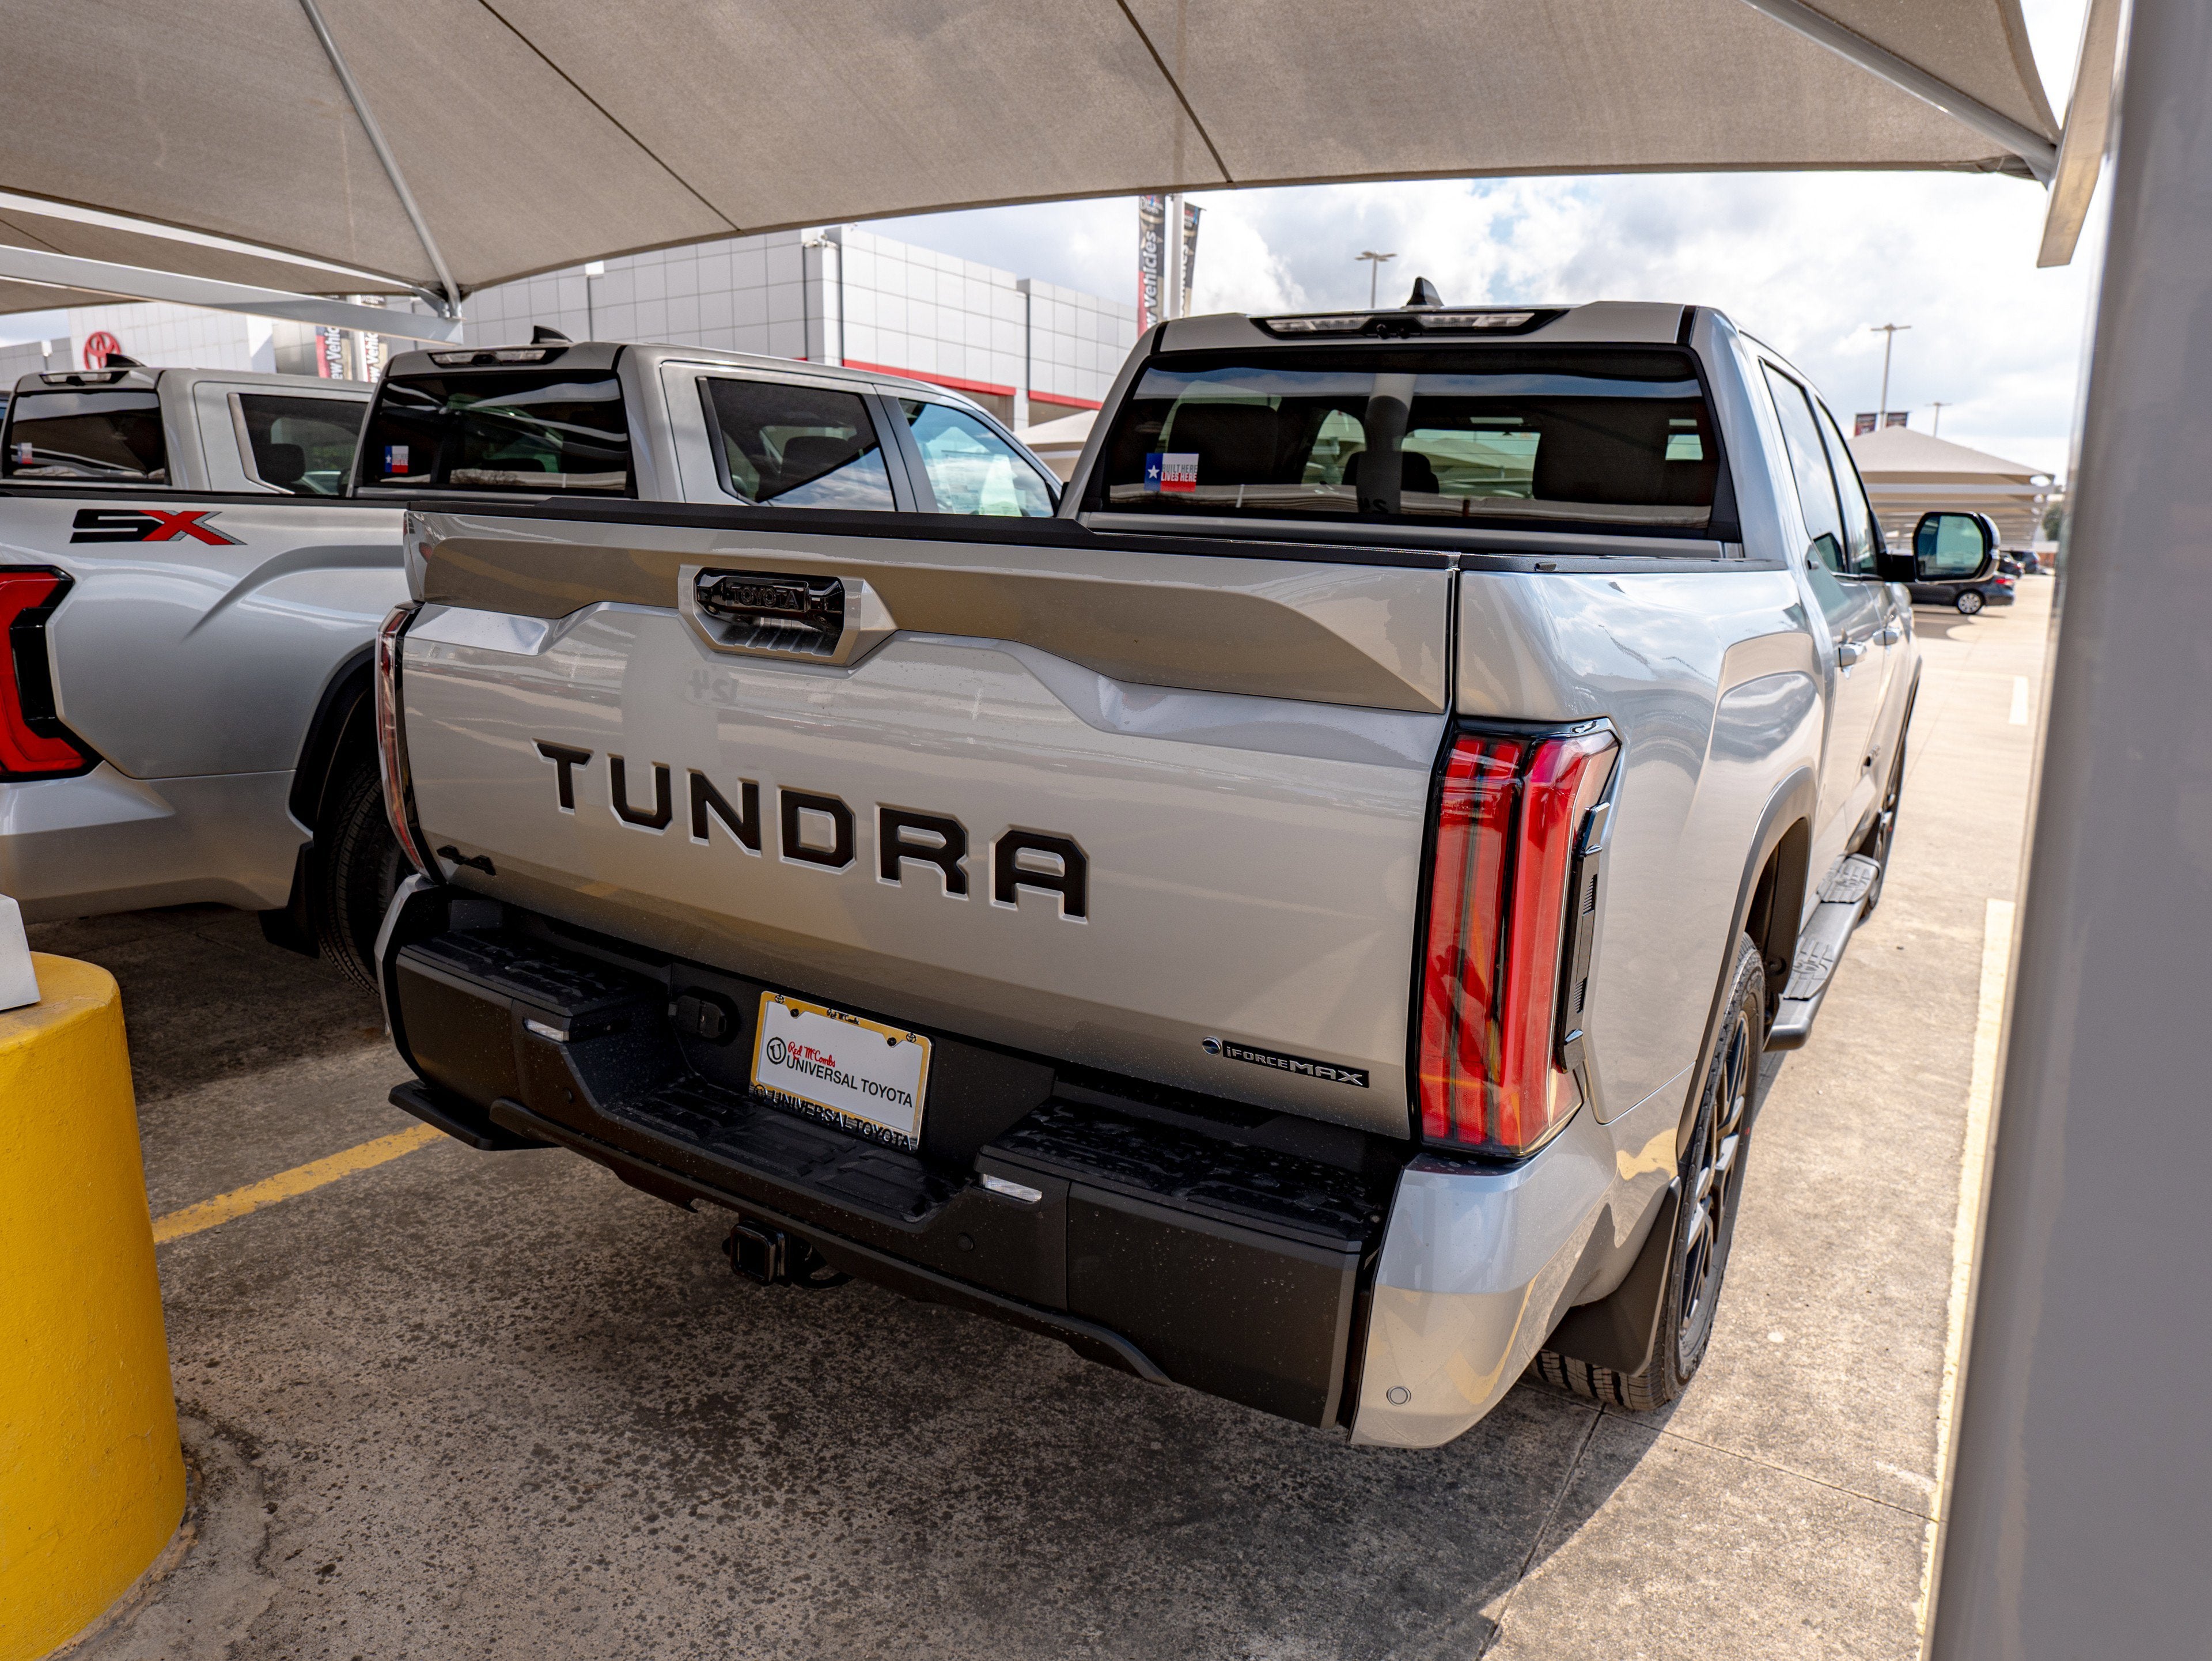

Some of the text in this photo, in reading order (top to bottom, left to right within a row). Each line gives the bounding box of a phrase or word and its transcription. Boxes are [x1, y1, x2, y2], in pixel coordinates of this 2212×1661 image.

[324, 327, 343, 380] ew Vehic
[1161, 472, 1197, 482] LIVES HERE
[1181, 464, 1198, 473] HERE
[730, 586, 799, 609] TOYOTA
[536, 741, 1088, 922] TUNDRA
[788, 1041, 835, 1068] Red McCombs
[787, 1055, 913, 1108] UNIVERSAL TOYOTA
[772, 1089, 852, 1129] UNIVERSAL
[854, 1118, 912, 1151] TOYOTA
